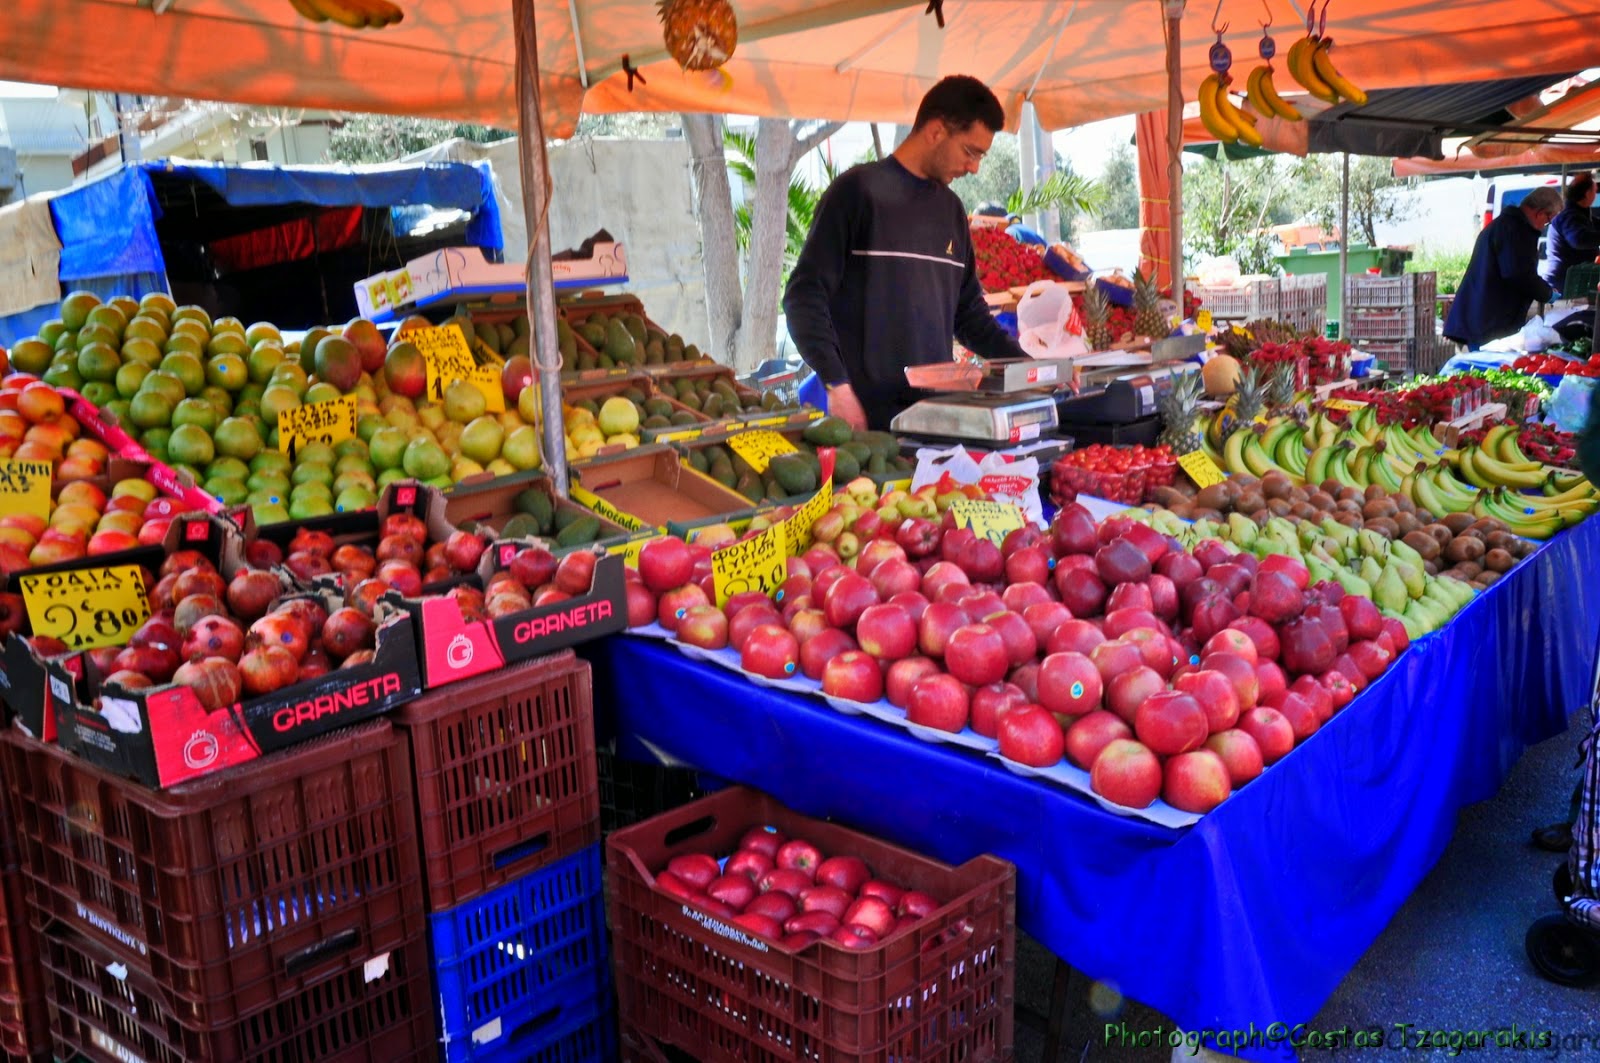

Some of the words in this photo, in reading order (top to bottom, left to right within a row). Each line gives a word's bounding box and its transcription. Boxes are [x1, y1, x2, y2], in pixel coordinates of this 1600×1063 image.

[593, 500, 640, 532] Avocado
[513, 600, 612, 644] GRANETA
[272, 672, 401, 733] GRANETA
